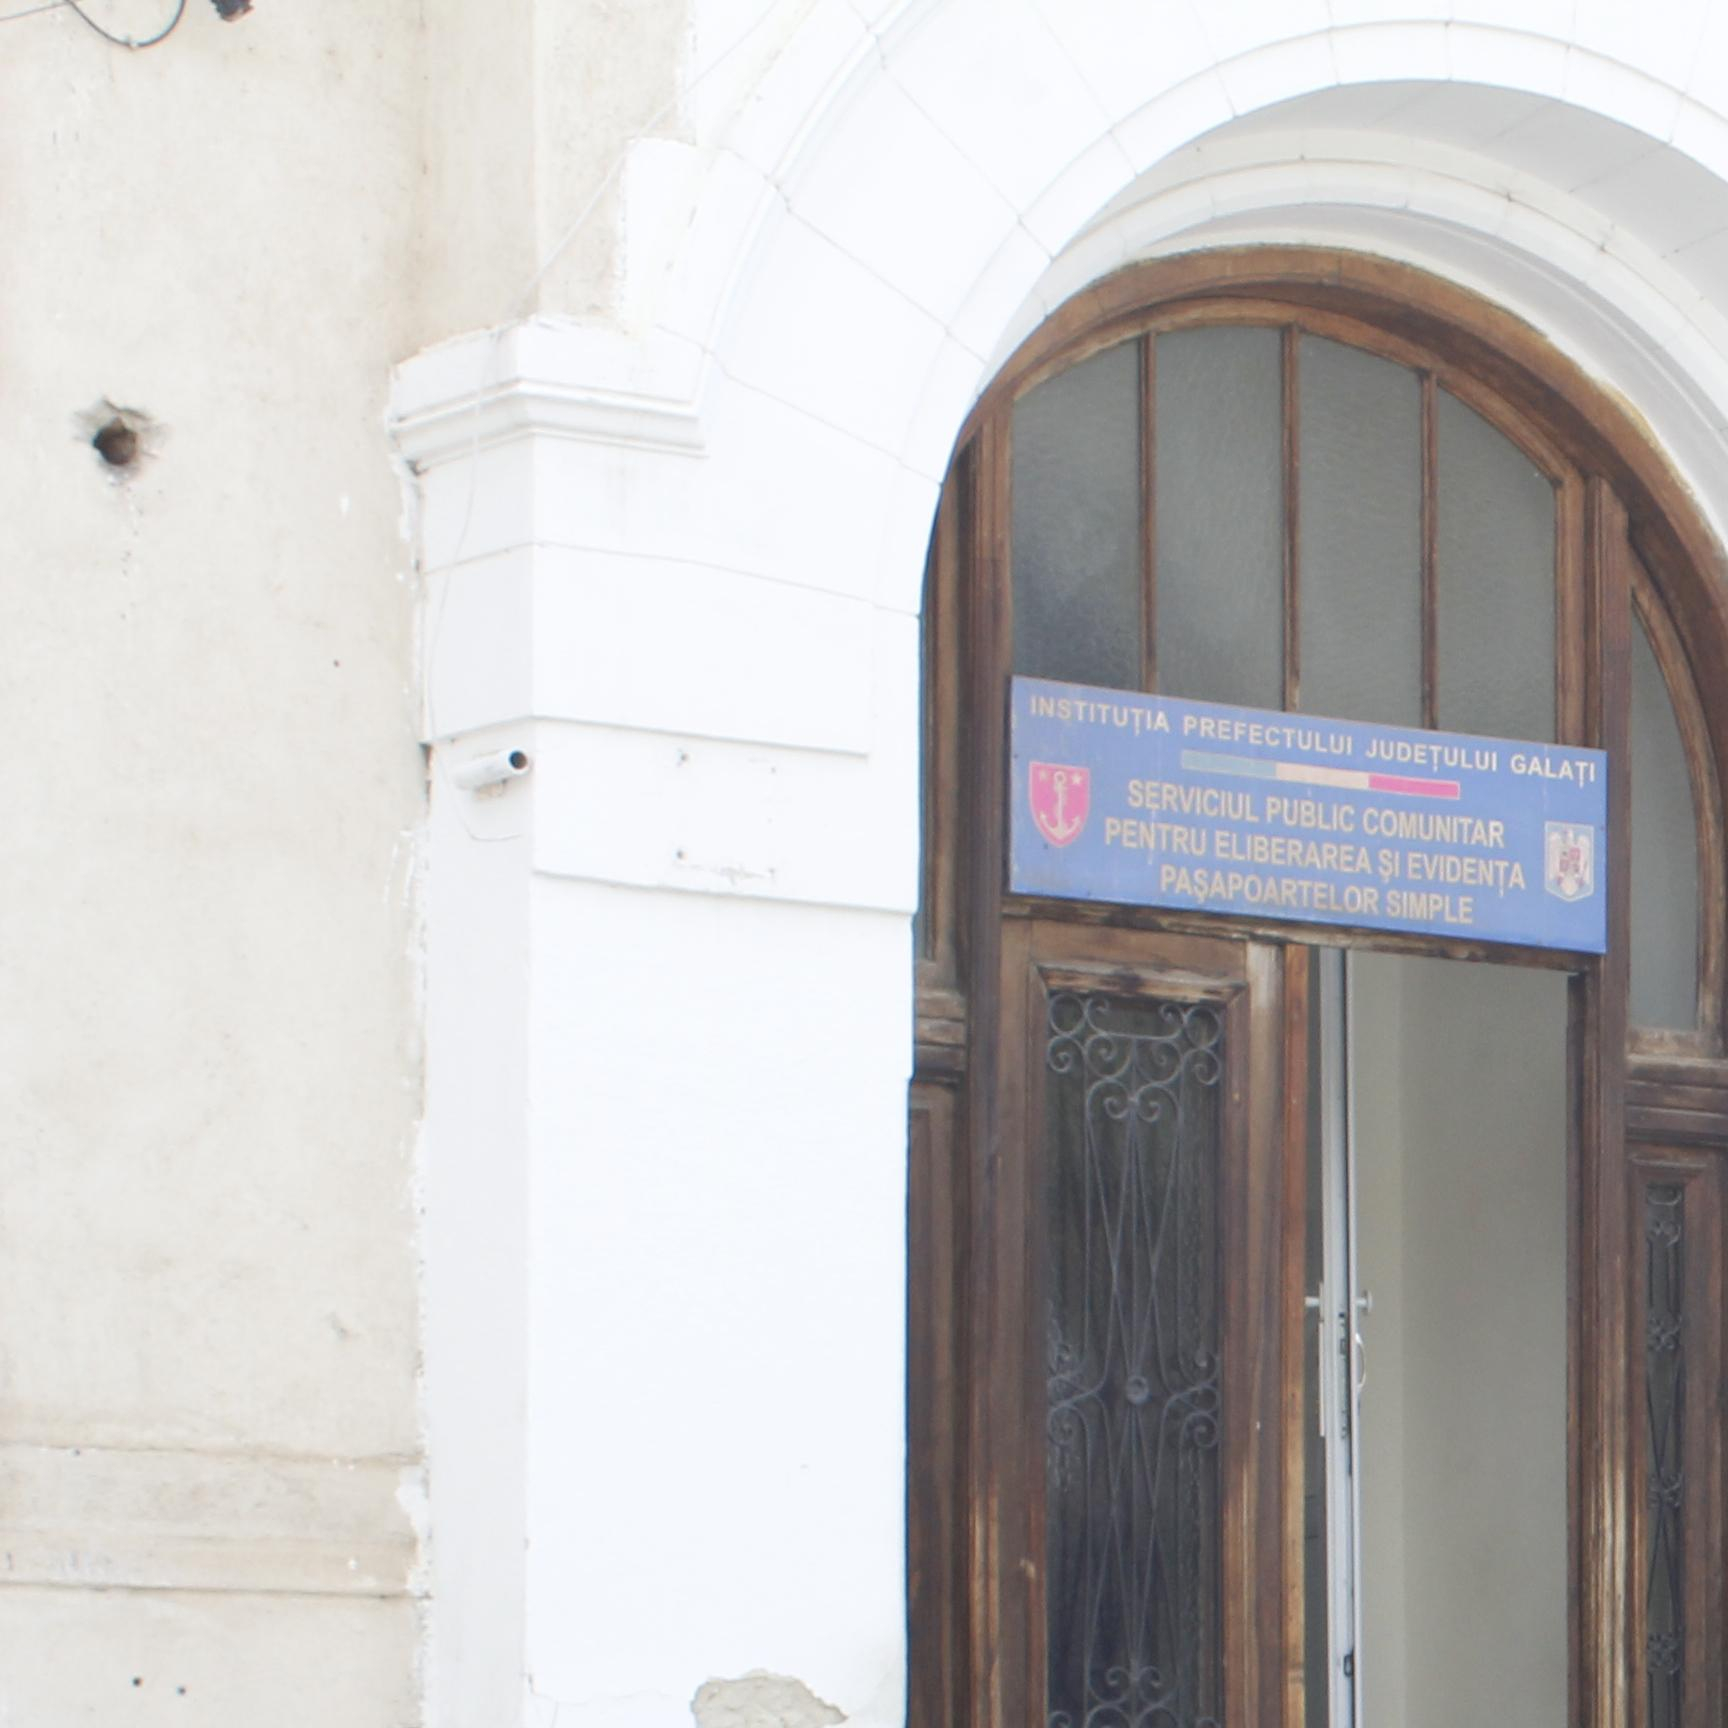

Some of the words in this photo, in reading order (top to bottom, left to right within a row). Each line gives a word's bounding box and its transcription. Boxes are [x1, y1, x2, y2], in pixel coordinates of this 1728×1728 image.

[1183, 715, 1353, 756] PREFECTULUI
[1128, 779, 1260, 823] SERVICIUL
[1266, 796, 1355, 833] PUBLIC
[1363, 807, 1505, 849] COMUNITAR
[1105, 816, 1207, 857] PENTRU
[1214, 829, 1373, 875] ELIBERAREA
[1386, 889, 1474, 925] SIMPLE
